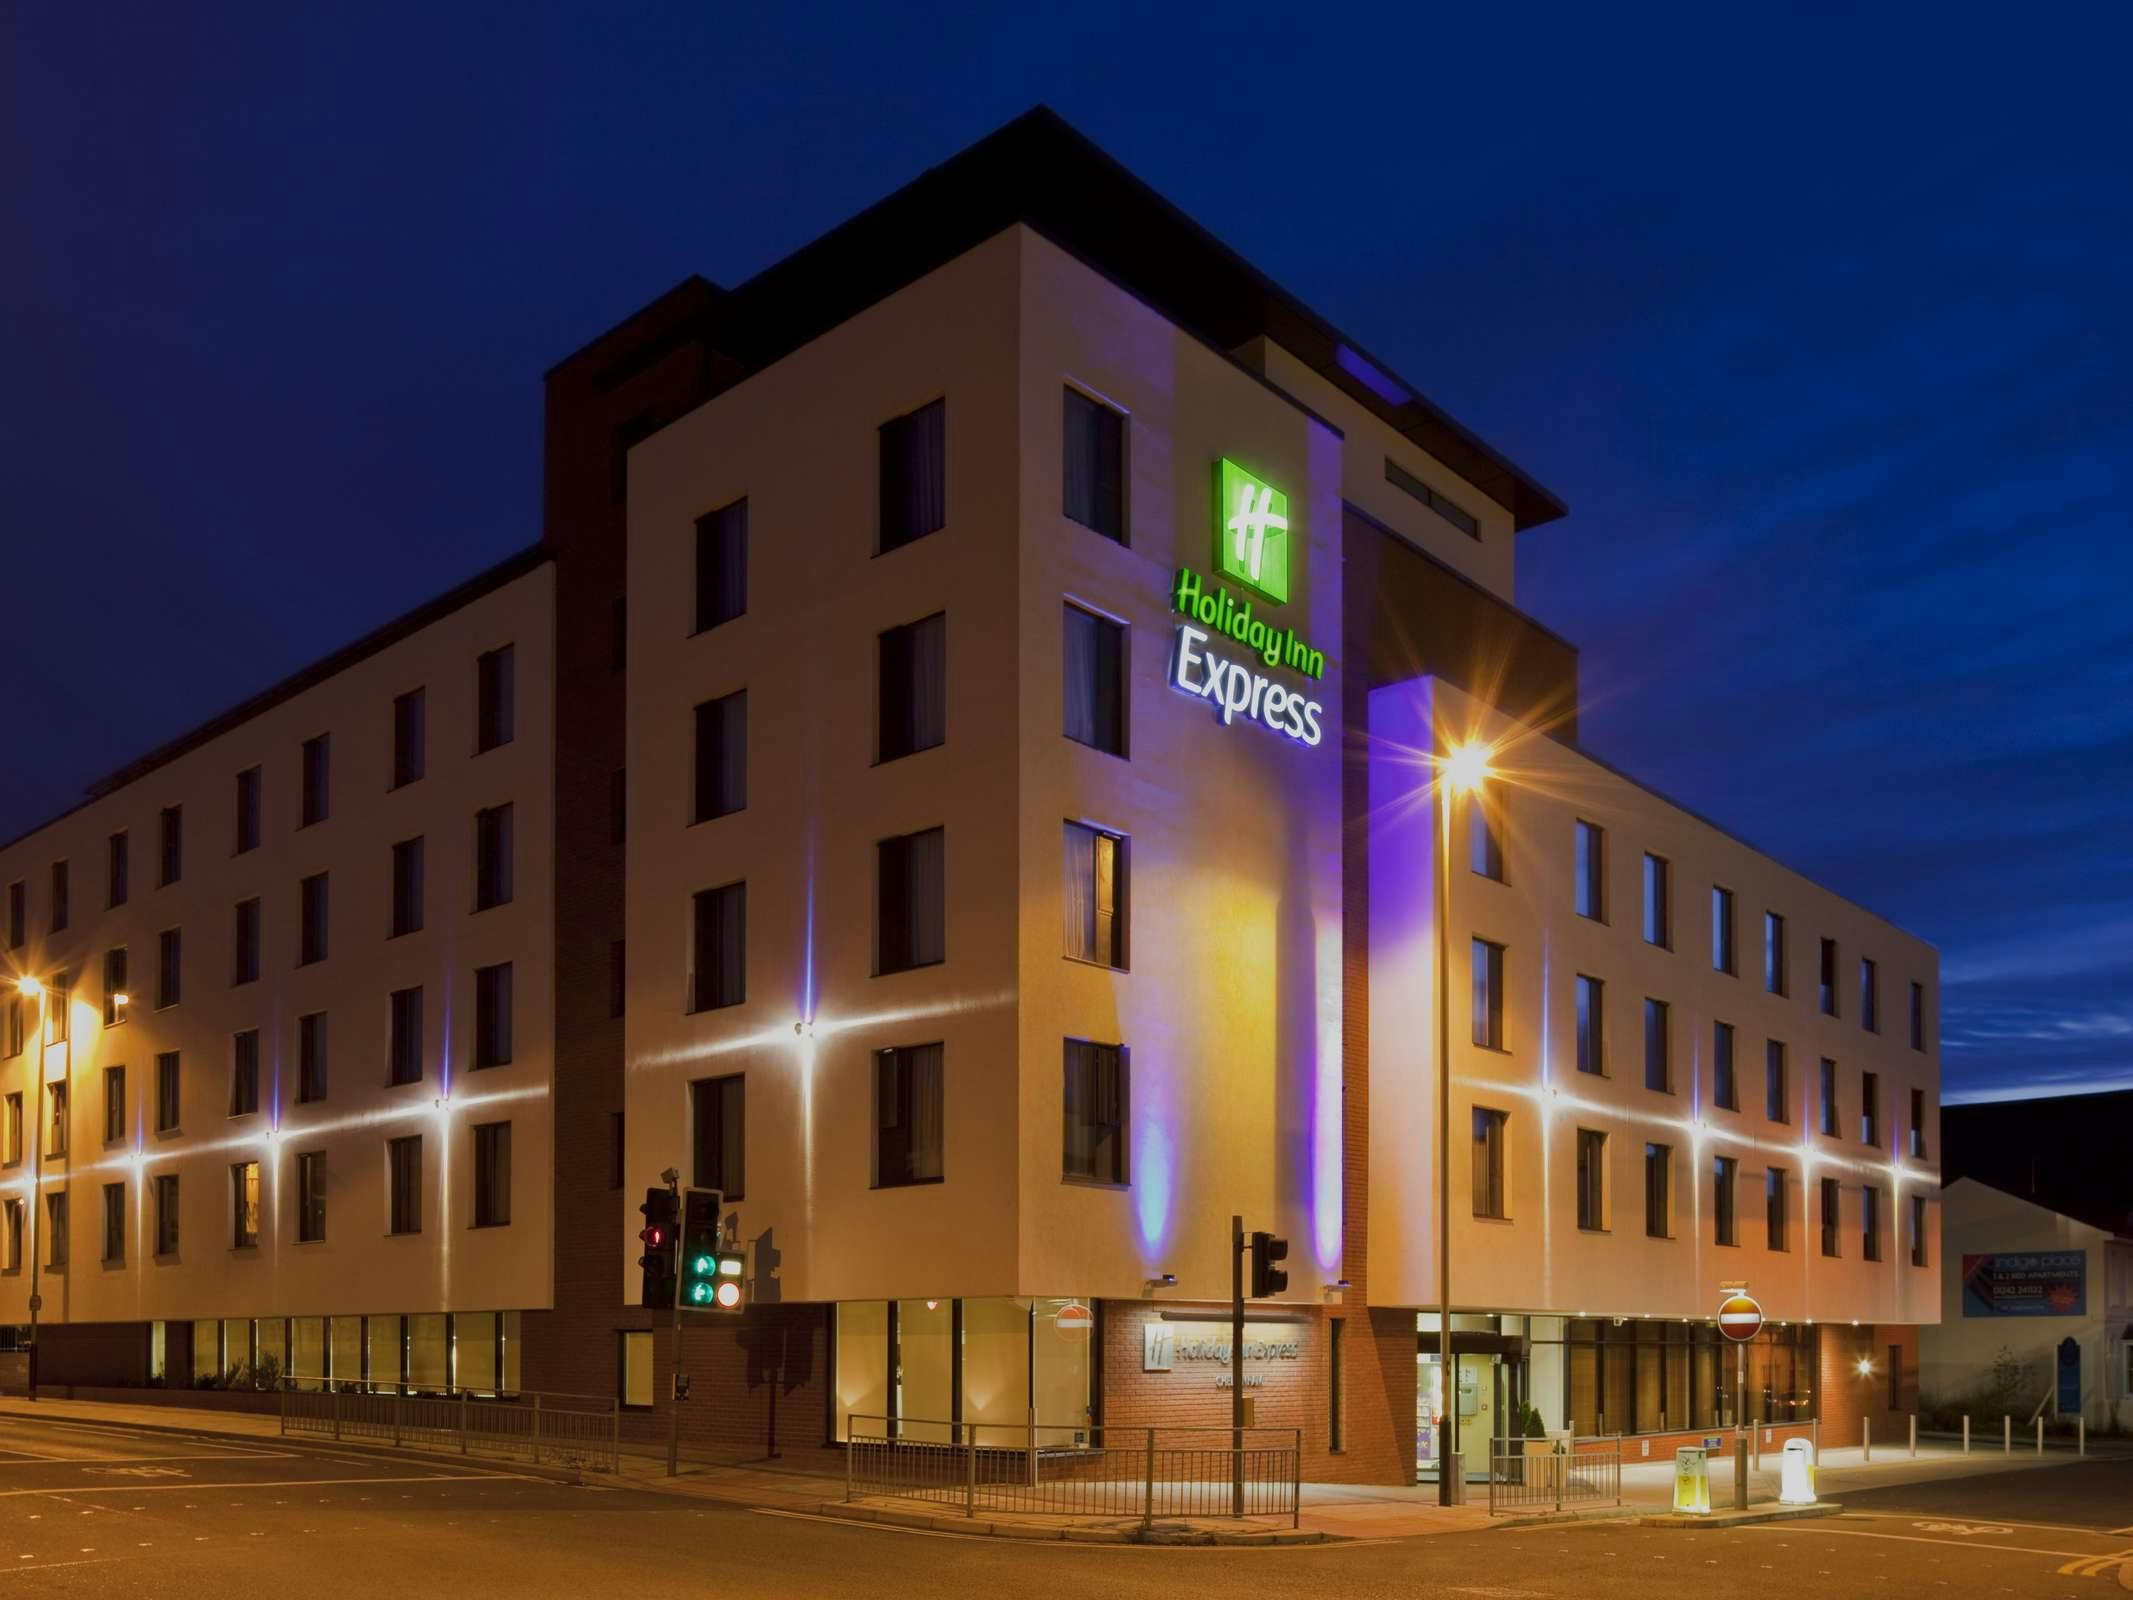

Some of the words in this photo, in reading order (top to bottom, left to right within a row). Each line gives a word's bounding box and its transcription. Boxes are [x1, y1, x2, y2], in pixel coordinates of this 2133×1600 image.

[1176, 566, 1283, 667] Holiday
[1285, 628, 1324, 680] Inn
[1177, 625, 1322, 746] Express
[2028, 1270, 2080, 1280] APARTMENTS
[1175, 1336, 1232, 1365] Holiday
